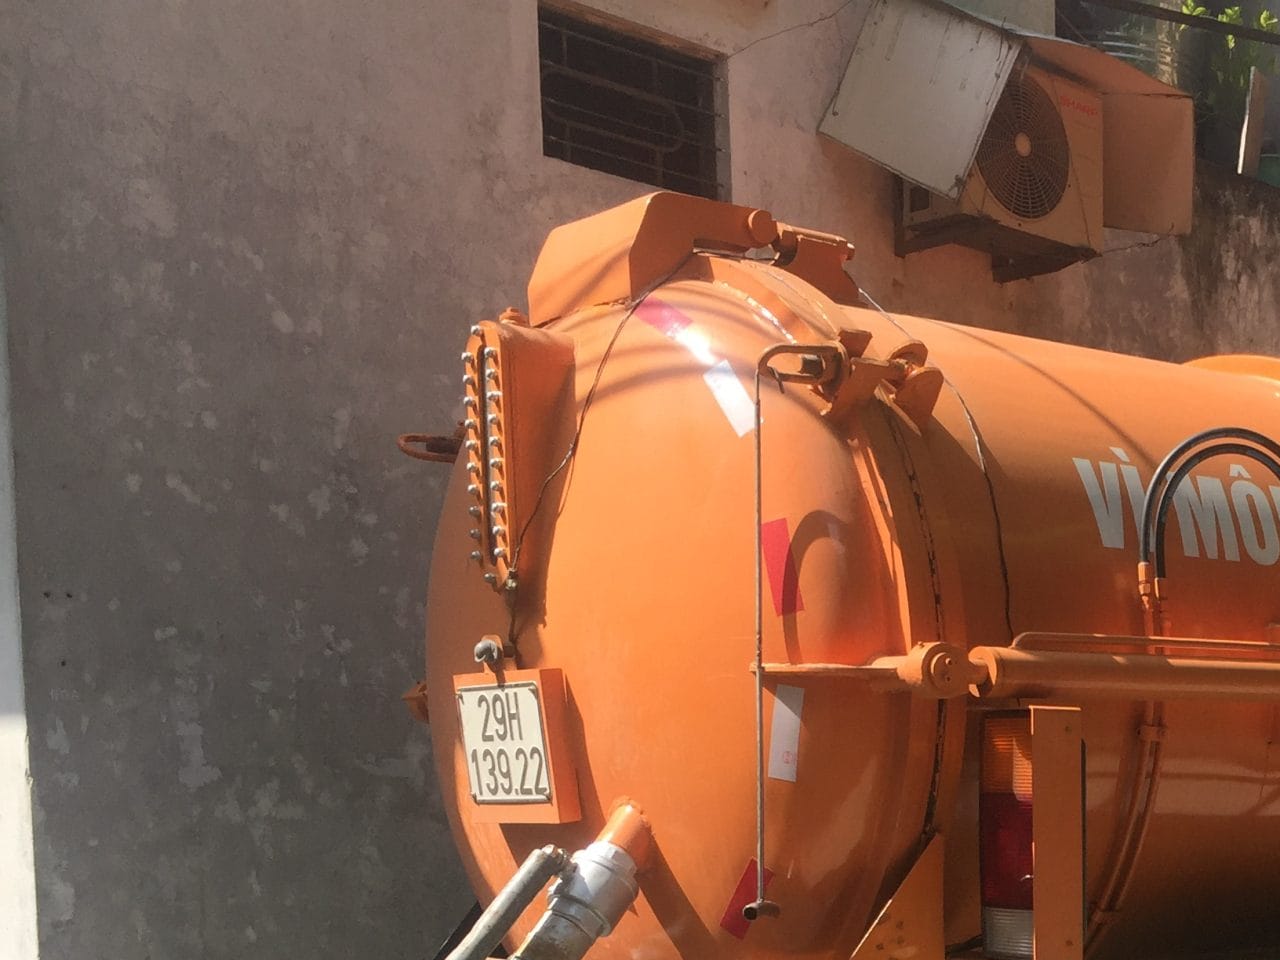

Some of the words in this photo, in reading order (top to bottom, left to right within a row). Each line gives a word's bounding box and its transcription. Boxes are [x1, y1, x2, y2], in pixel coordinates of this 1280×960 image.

[1072, 447, 1154, 552] VÌ
[477, 691, 524, 742] 29H
[471, 746, 548, 797] 139.22
